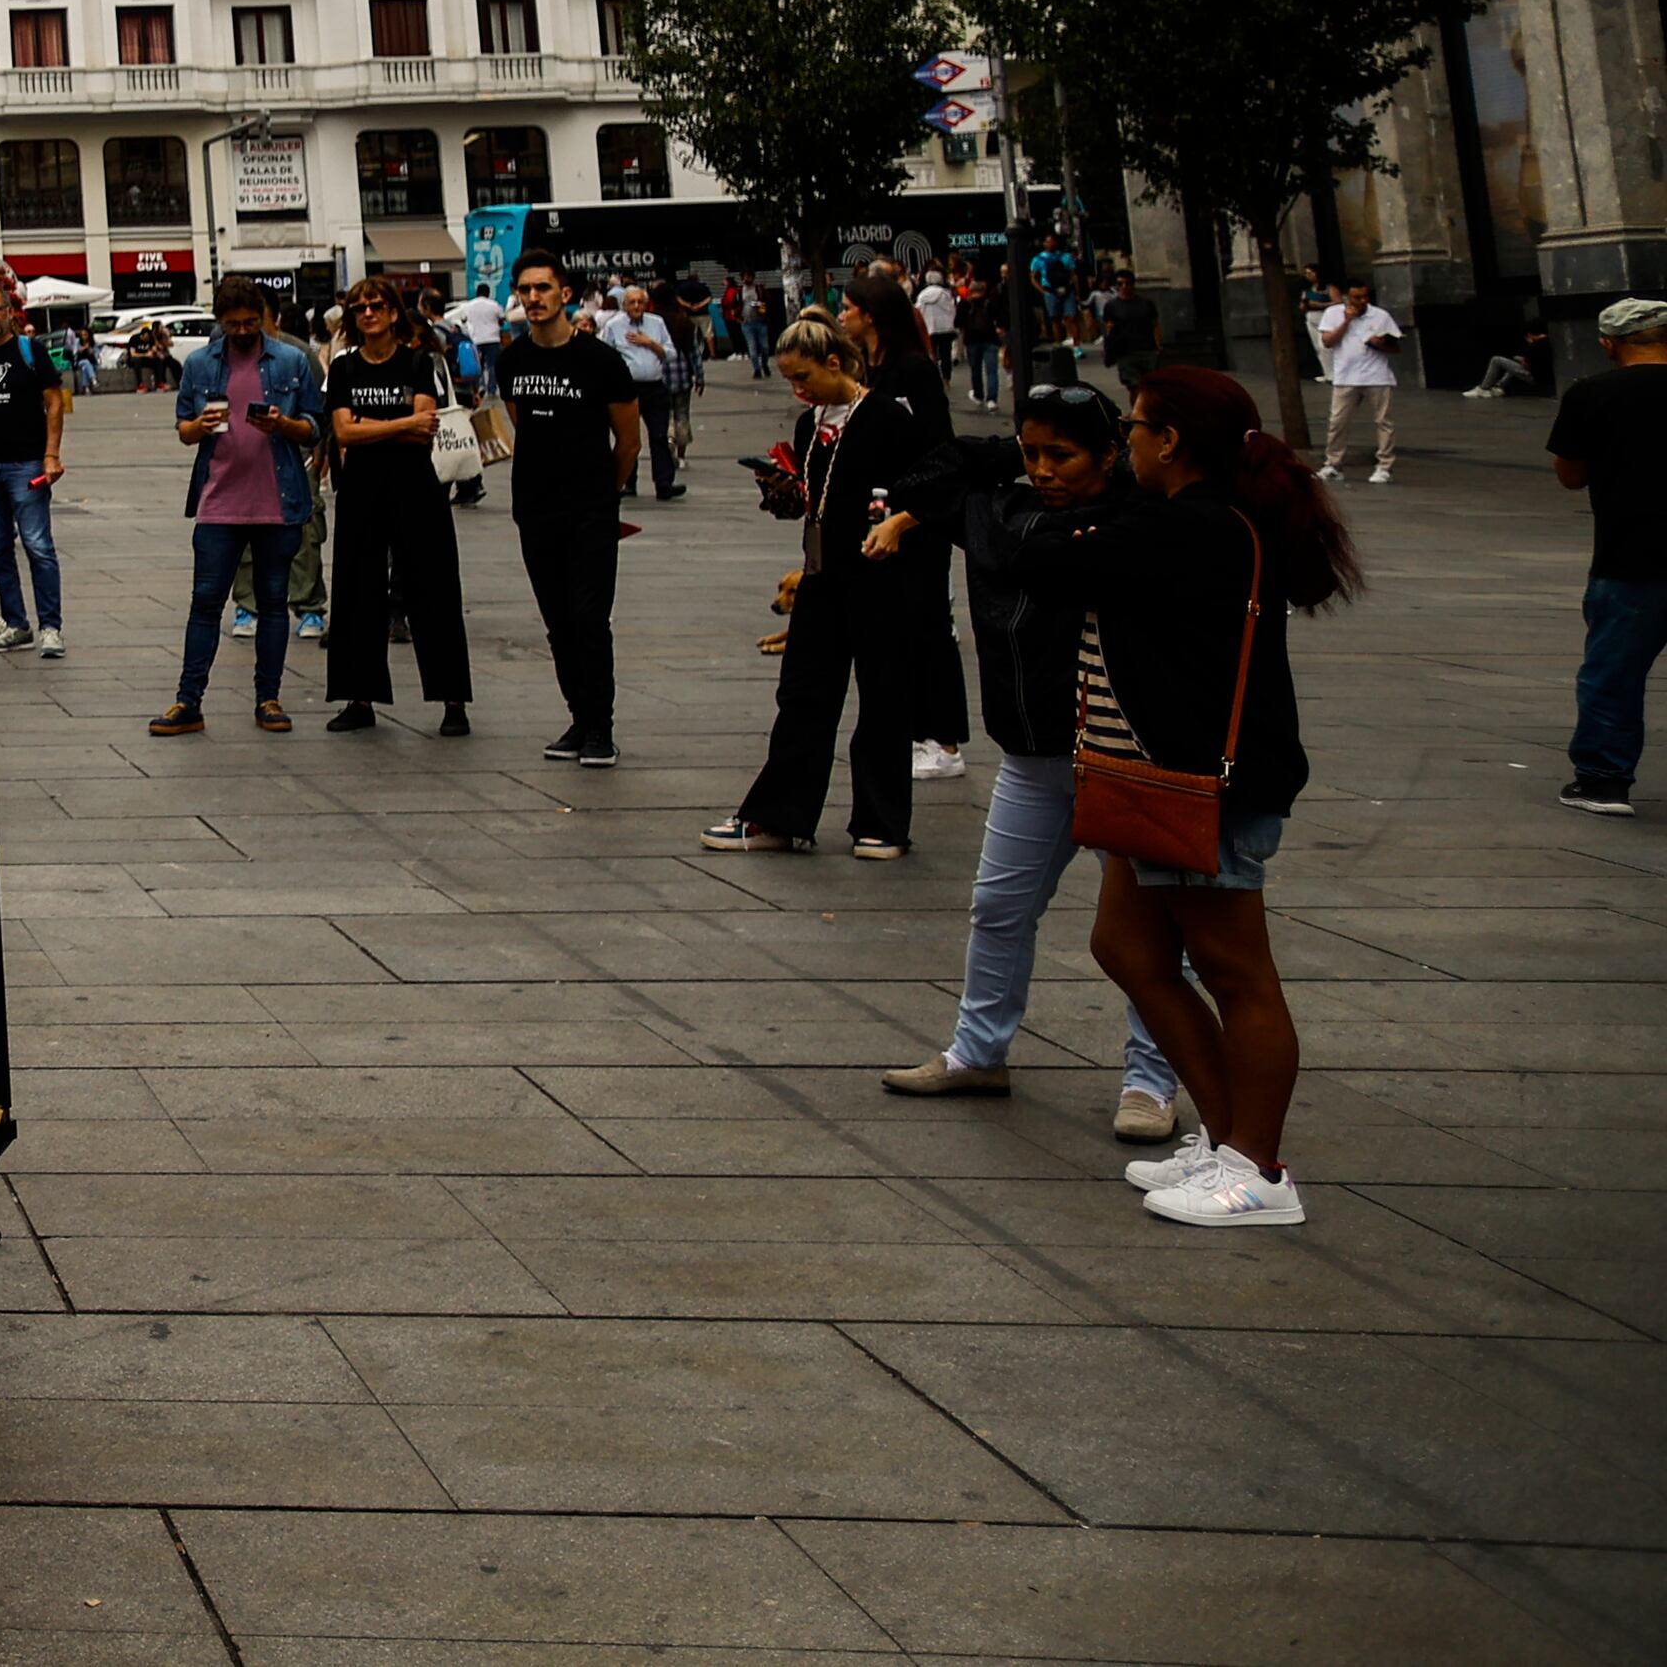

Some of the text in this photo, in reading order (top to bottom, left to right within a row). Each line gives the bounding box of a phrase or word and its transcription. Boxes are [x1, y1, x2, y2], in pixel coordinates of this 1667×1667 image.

[242, 153, 293, 164] OFICINAS
[243, 165, 293, 176] SALAS DE
[238, 176, 300, 186] REUNIONES
[238, 194, 249, 204] 91
[253, 194, 271, 204] 104
[290, 192, 303, 203] 97
[837, 223, 893, 245] MADRID
[138, 252, 164, 263] FIVE
[299, 250, 316, 261] 44
[561, 248, 655, 270] LÍNEA CERO
[136, 261, 168, 272] GUYS
[513, 375, 558, 387] FESTIVAL
[512, 385, 582, 400] DE LAS IDEAS
